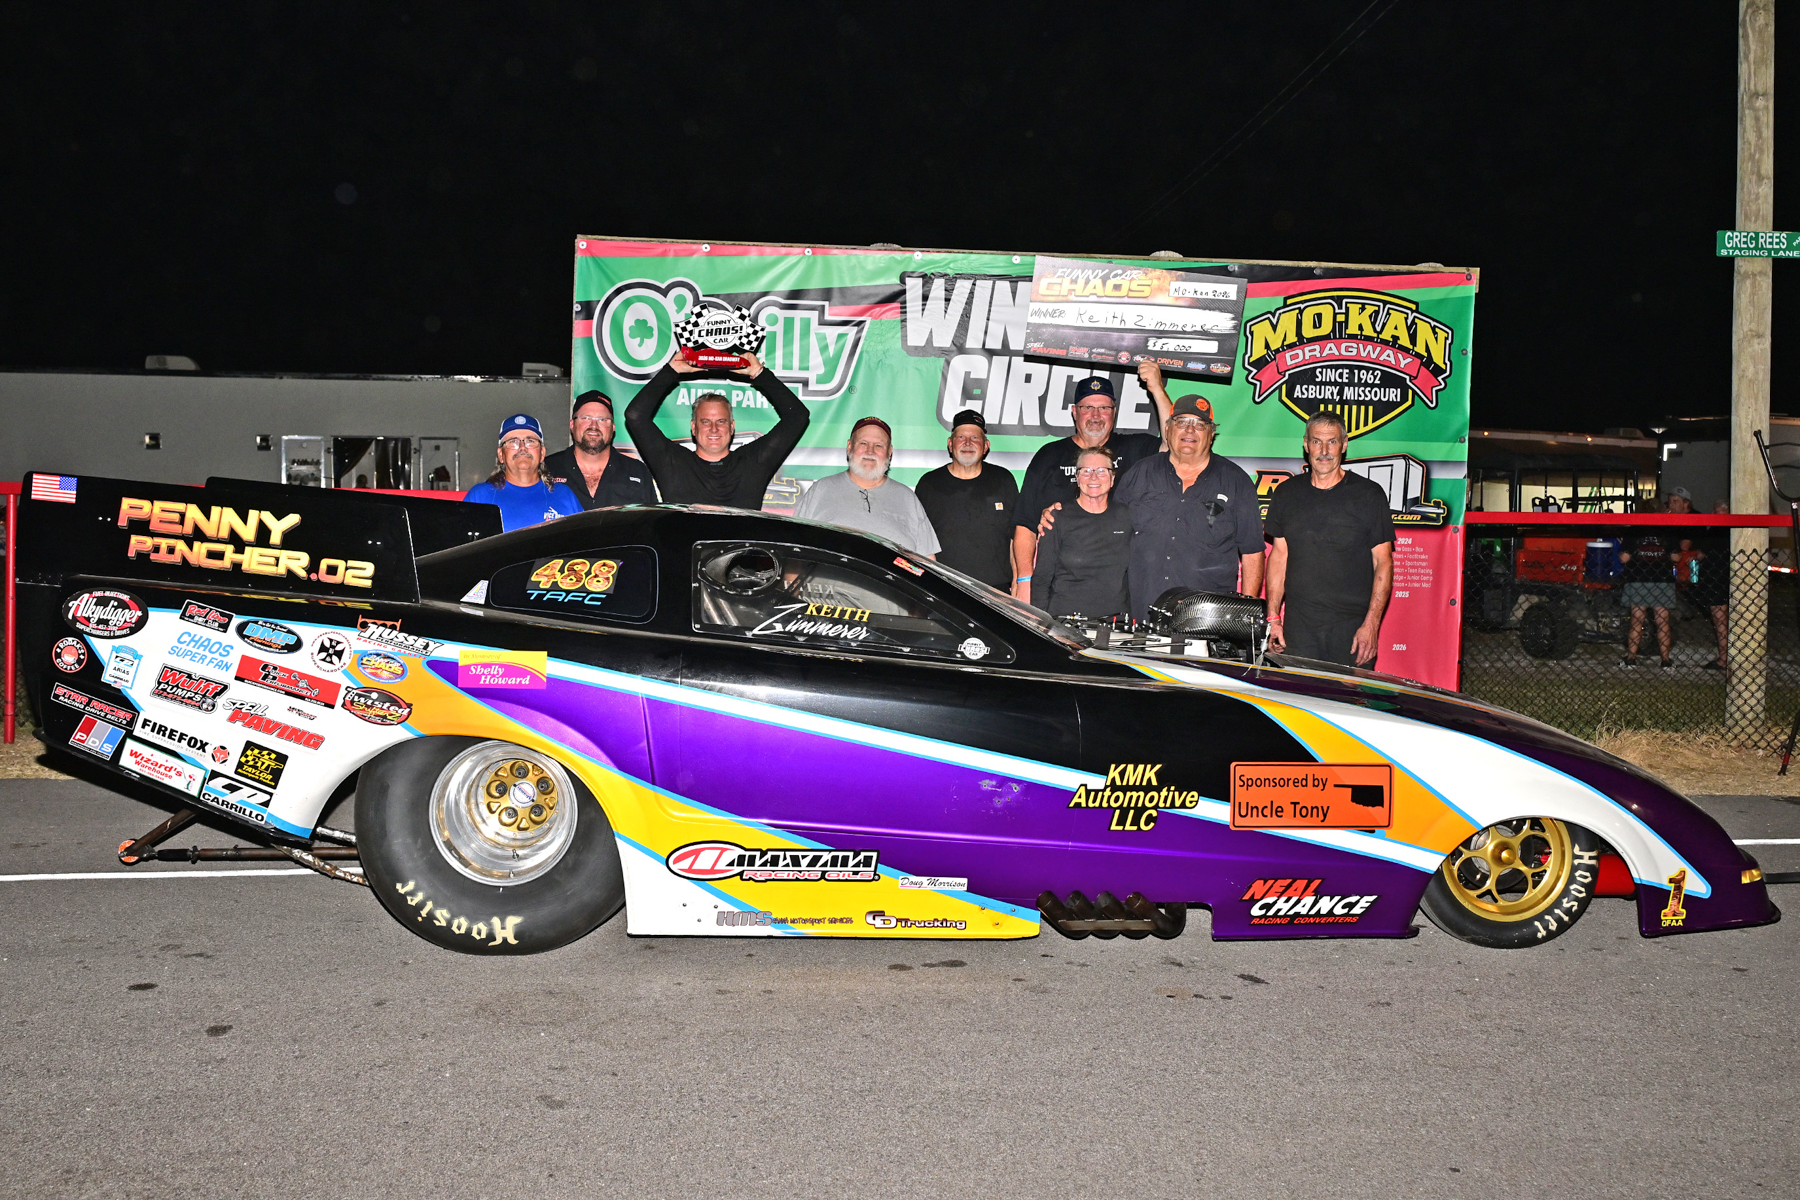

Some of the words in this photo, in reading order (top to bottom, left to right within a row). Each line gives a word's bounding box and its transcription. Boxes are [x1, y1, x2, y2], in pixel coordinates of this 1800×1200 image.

[1725, 232, 1756, 248] GREG
[1758, 233, 1787, 249] REES
[1720, 249, 1768, 257] STAGING
[1054, 269, 1109, 280] FUNNY
[1110, 270, 1143, 281] CAR
[1038, 278, 1153, 298] CHAOS
[1076, 307, 1126, 327] Keith
[697, 325, 743, 338] CHAOS!
[1250, 303, 1449, 370] MO-KAN
[1030, 346, 1067, 356] PAVING
[1285, 341, 1414, 371] DRAGWAY
[1157, 357, 1184, 367] DRIVEN
[1315, 368, 1349, 383] SINCE
[1353, 369, 1382, 384] 1962
[1294, 385, 1339, 402] ASBURY,
[1343, 386, 1401, 402] MISSOURI
[118, 497, 301, 548] PENNY
[1397, 537, 1412, 545] 2024
[128, 535, 375, 588] PINCHER.02
[530, 559, 618, 592] 488
[526, 590, 607, 606] TAFC
[68, 593, 143, 626] Alkydigger
[186, 605, 208, 617] Red
[206, 609, 228, 624] Line
[805, 602, 872, 623] KEITH
[751, 603, 870, 640] Zimmerer
[176, 631, 234, 658] CHAOS
[243, 623, 298, 646] DMP
[356, 637, 388, 649] RACING
[358, 623, 445, 653] HUSSEY
[376, 637, 431, 655] PERFORMANCE
[56, 658, 80, 670] COFFEE
[168, 645, 207, 665] SUPER
[206, 657, 233, 672] FAN
[362, 657, 403, 675] CHAOS
[113, 666, 129, 675] ARIAS
[259, 663, 290, 678] QUICK
[469, 665, 505, 677] Shelly
[479, 675, 530, 685] Howard
[158, 683, 203, 702] PUMPS
[160, 668, 224, 696] Wulff
[259, 672, 312, 697] PERFORMANCE
[55, 686, 88, 704] STAR
[90, 700, 133, 721] RACER
[59, 696, 85, 710] RACING
[85, 706, 106, 717] DRIVE
[106, 713, 127, 725] BELTS
[222, 698, 269, 717] SPELL
[344, 686, 412, 715] Twisted
[141, 718, 209, 754] FIREFOX
[226, 708, 325, 750] PAVING
[74, 732, 113, 753] PDS
[129, 749, 183, 777] Wizard's
[134, 759, 173, 780] Warehouse
[242, 765, 273, 781] TAYLOR
[1105, 764, 1162, 786] KMK
[1238, 775, 1308, 791] Sponsored
[1311, 774, 1328, 791] by
[202, 792, 265, 822] CARRILLO
[1069, 786, 1199, 808] Automotive
[1109, 809, 1158, 831] LLC
[1238, 801, 1284, 819] Uncle
[1290, 802, 1330, 822] Tony
[725, 851, 878, 871] MAXIMA
[743, 870, 821, 881] RACING
[826, 871, 874, 880] OILS
[900, 877, 924, 888] Doug
[927, 878, 966, 888] Morrison
[1242, 878, 1323, 901] NEAL
[1537, 844, 1599, 938] Hoosier
[1661, 868, 1687, 919] 1
[396, 880, 525, 946] Hoosier
[1249, 895, 1378, 916] CHANCE
[716, 911, 772, 927] HMS
[899, 918, 967, 930] Trucking
[1250, 916, 1291, 925] RACING
[1293, 916, 1359, 925] CONVERTERS
